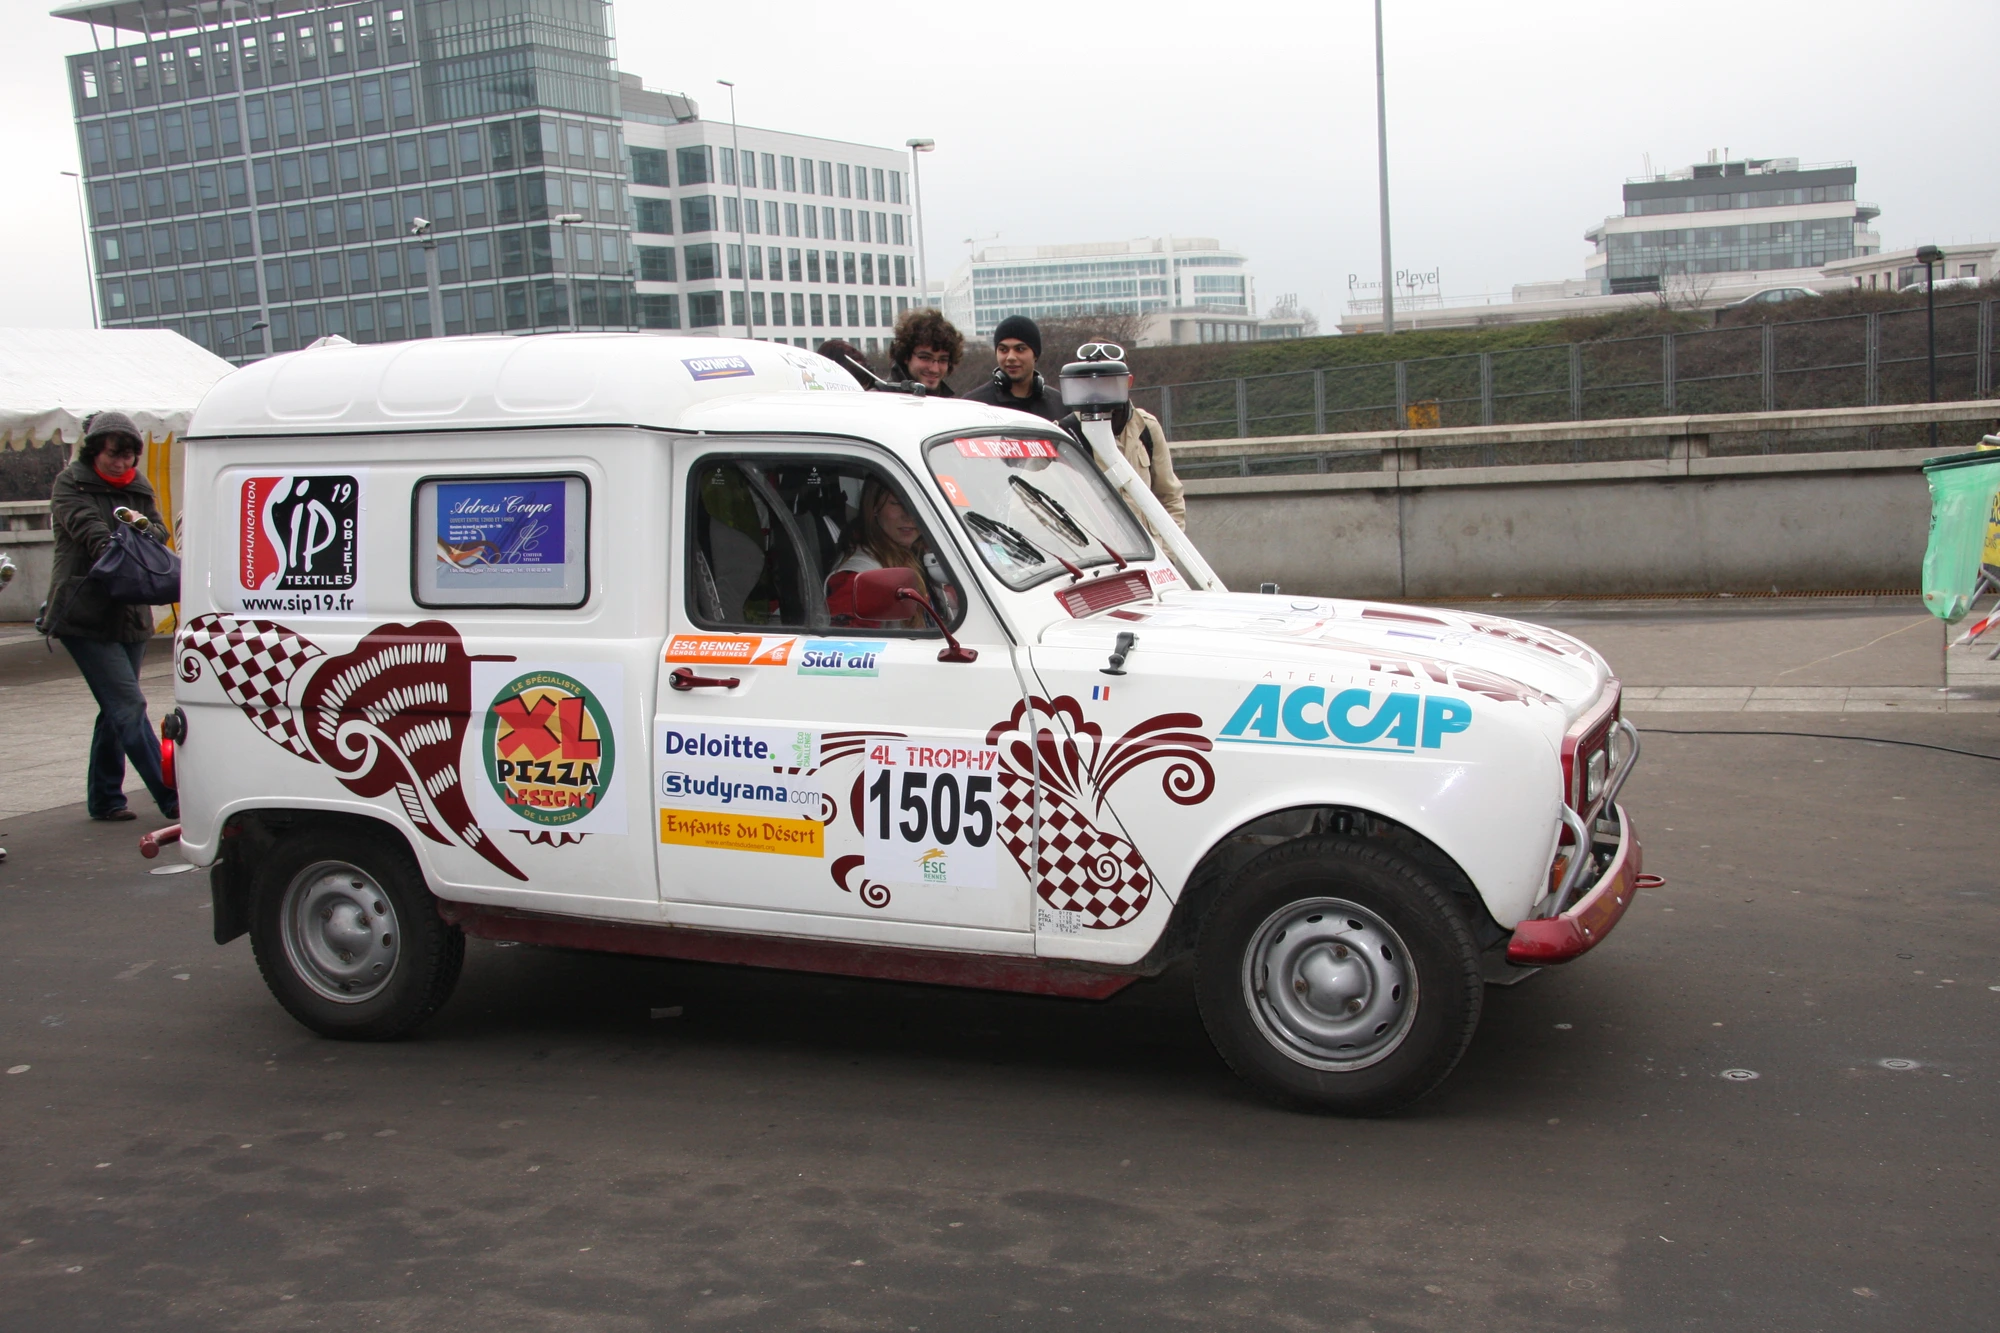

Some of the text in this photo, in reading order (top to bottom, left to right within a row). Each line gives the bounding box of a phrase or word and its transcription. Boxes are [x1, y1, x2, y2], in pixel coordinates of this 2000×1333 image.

[1396, 266, 1440, 290] Pleyel
[689, 357, 746, 373] OLYMPUS
[968, 441, 986, 457] 4L
[984, 441, 1024, 457] TROPHY
[331, 483, 352, 503] 19
[944, 481, 957, 499] P
[246, 480, 256, 588] COMMUNICATION
[343, 518, 354, 585] OBJETS
[285, 575, 353, 585] TEXTILES
[242, 592, 354, 615] www.sip19.fr
[673, 640, 751, 651] ESC RENNES
[801, 651, 876, 669] Sidi ali
[511, 674, 581, 694] LE SPÉCIALISTE
[1262, 670, 1422, 690] ATELIERS
[1219, 683, 1473, 749] ACCAP
[492, 694, 601, 761] XL
[869, 745, 998, 771] 4L TROPHY
[496, 759, 600, 787] PIZZA
[504, 788, 597, 810] LESIGNY
[869, 769, 994, 848] 1505
[523, 809, 578, 823] DE LA PIZZA
[667, 814, 815, 844] Enfants du Désert
[923, 861, 947, 874] ESC
[923, 873, 947, 881] RENNES
